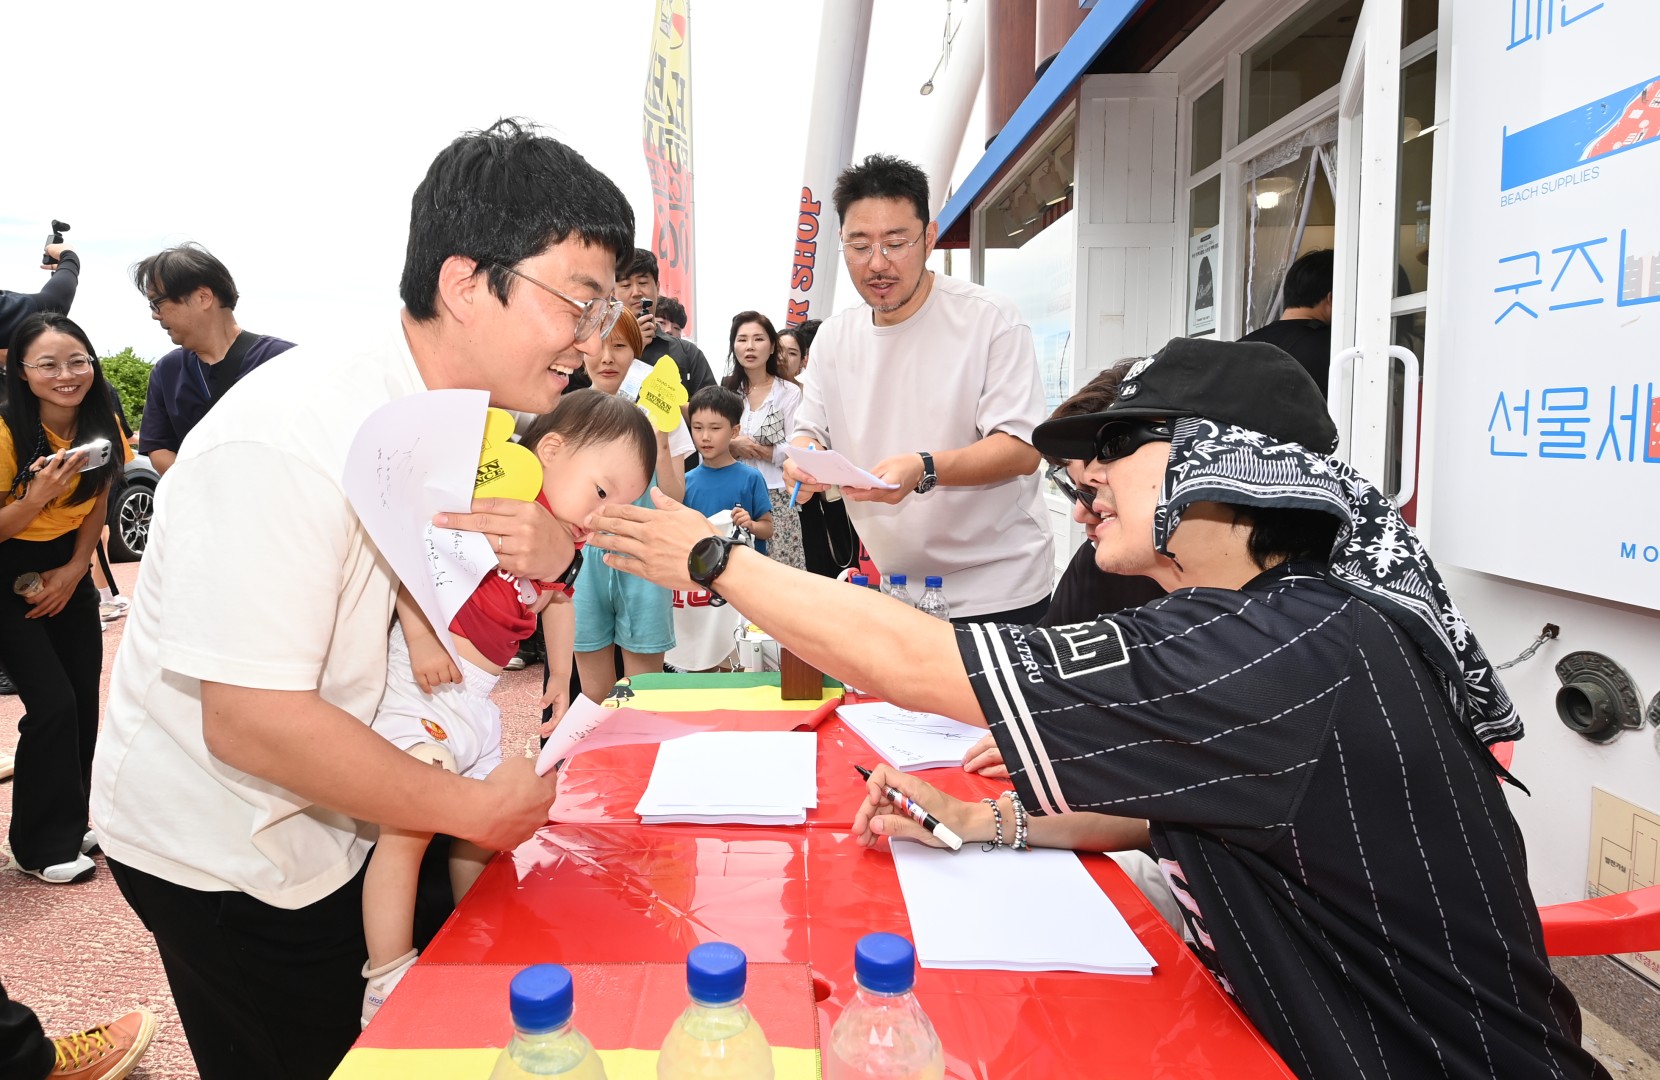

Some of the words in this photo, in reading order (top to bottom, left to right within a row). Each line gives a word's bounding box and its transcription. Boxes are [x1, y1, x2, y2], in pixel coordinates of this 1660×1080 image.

[1500, 186, 1538, 208] BEACH
[1541, 166, 1600, 194] SUPPLIES
[791, 186, 822, 292] SHOP
